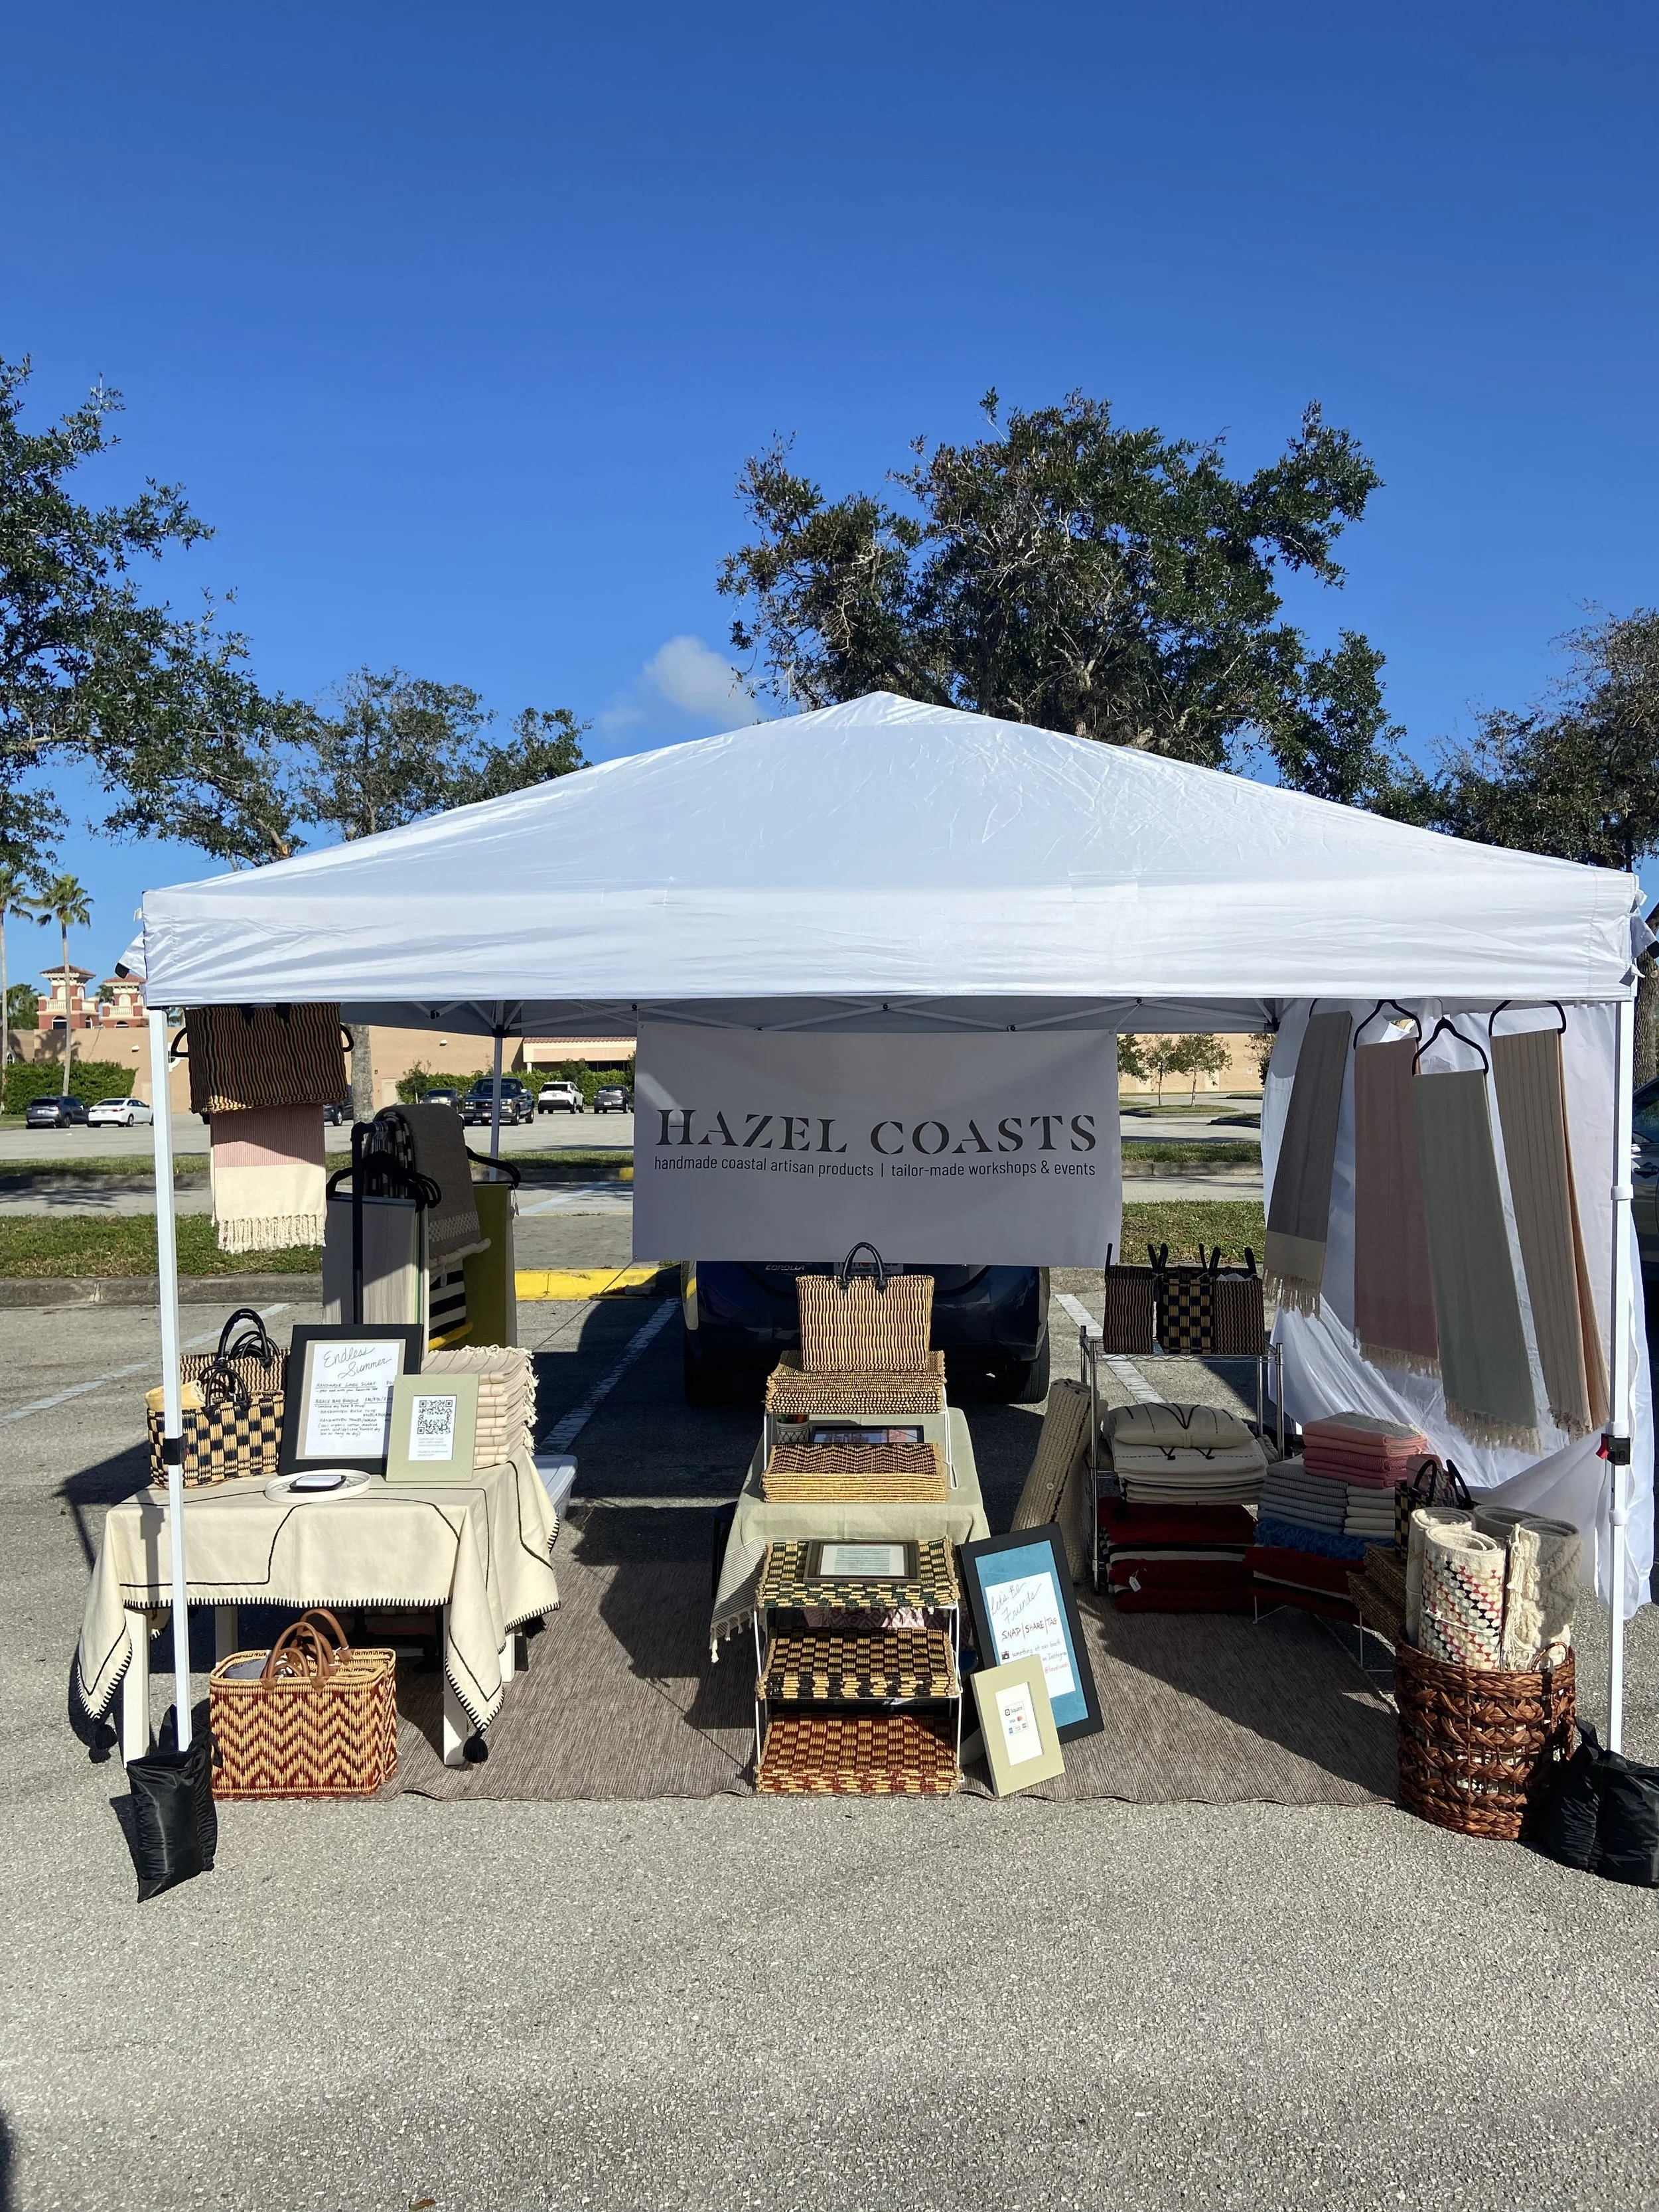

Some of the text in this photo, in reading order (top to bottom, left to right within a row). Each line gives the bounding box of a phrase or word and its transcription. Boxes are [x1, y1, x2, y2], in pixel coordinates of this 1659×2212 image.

[655, 1109, 1096, 1155] HAZEL COASTS
[654, 1155, 717, 1170] handmade
[721, 1157, 766, 1171] coastal
[770, 1159, 814, 1174] artisan
[818, 1162, 874, 1177] products
[891, 1163, 964, 1177] tailor-made
[968, 1161, 1037, 1177] workshops
[1041, 1159, 1050, 1175] &
[1054, 1161, 1096, 1175] events
[323, 1347, 375, 1368] Endless
[338, 1359, 392, 1378] Summer
[991, 1591, 1009, 1616] Let's
[1001, 1583, 1042, 1625] Friends
[1001, 1627, 1021, 1642] SNAP
[1025, 1620, 1045, 1633] SHARE
[1046, 1617, 1058, 1627] TAG
[1012, 1649, 1033, 1657] something
